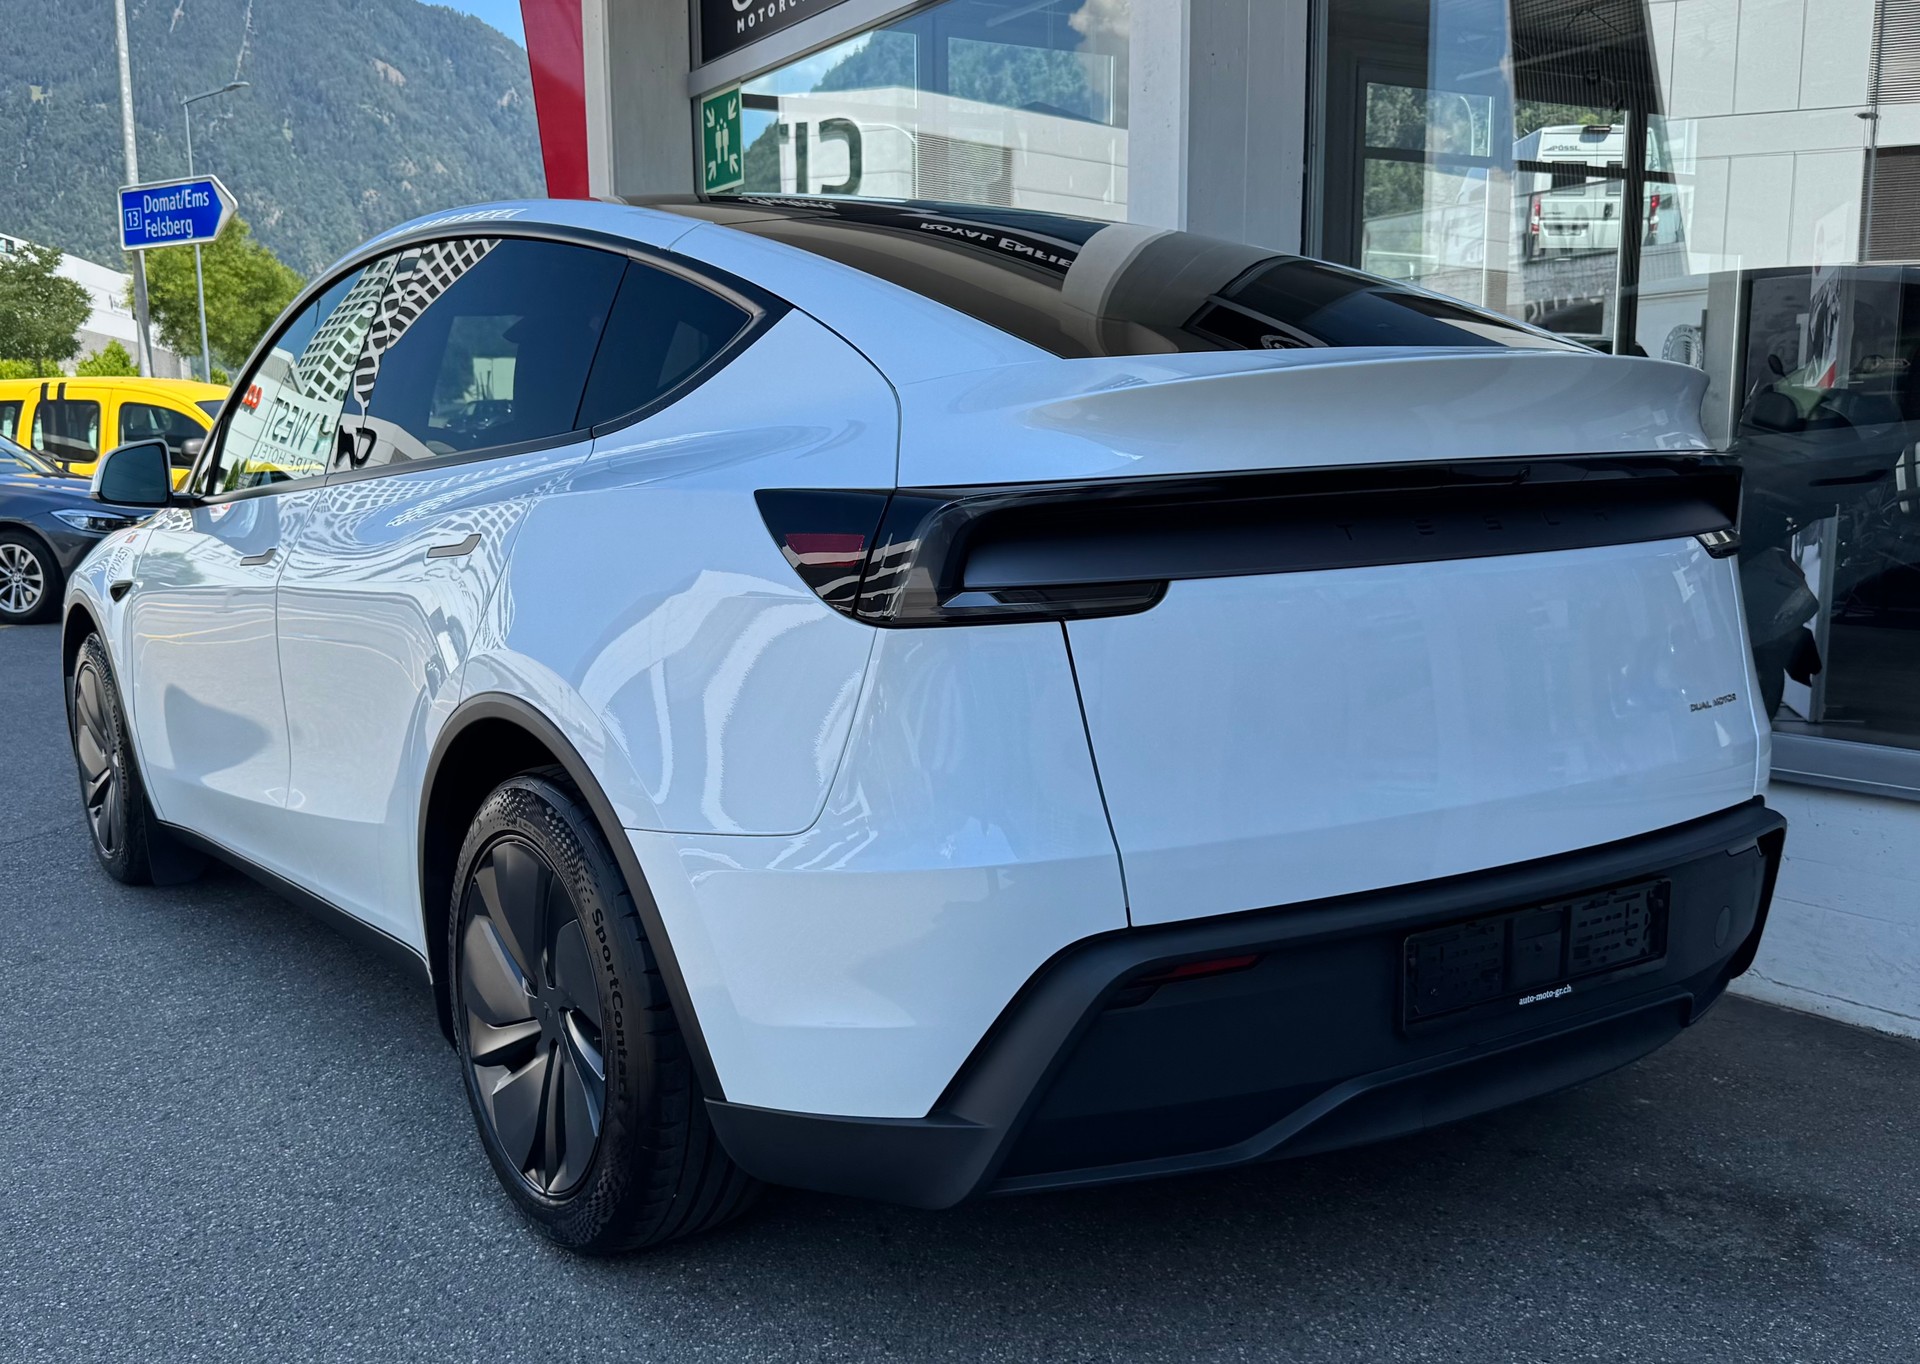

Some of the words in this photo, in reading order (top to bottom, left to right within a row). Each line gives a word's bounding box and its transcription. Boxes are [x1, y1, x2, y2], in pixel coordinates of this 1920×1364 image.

[737, 0, 805, 34] MOTORC
[144, 189, 210, 214] Domat/Ems
[127, 211, 139, 227] 13
[145, 216, 194, 239] Felsberg
[1334, 508, 1610, 543] TESLA
[1690, 700, 1712, 712] DUAL
[1518, 983, 1573, 1007] auto-moto-gr.ch
